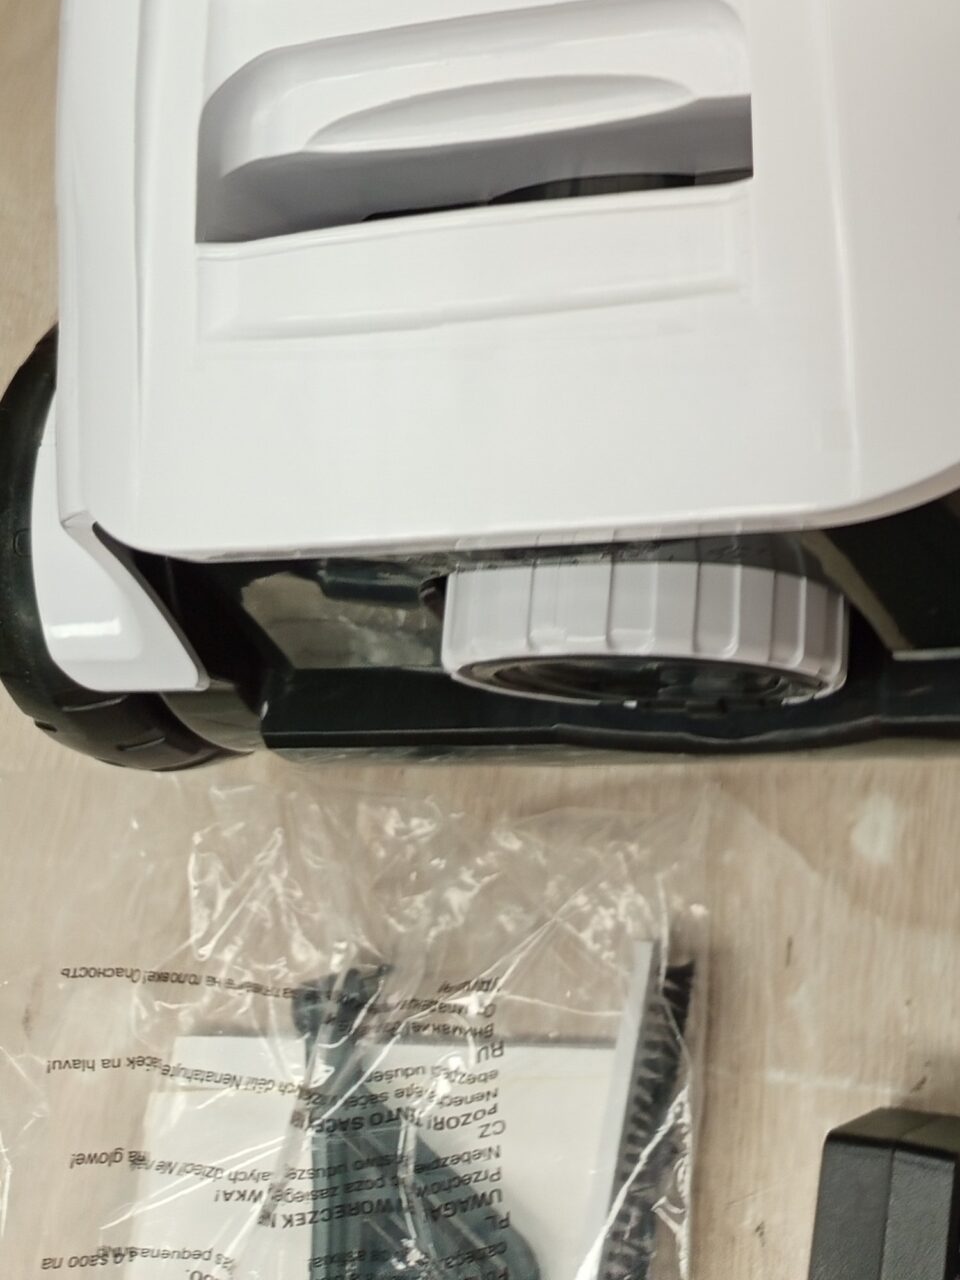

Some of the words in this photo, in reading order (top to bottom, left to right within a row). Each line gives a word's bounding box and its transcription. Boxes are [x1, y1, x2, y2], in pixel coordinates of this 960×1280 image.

[476, 1040, 505, 1064] RU
[45, 1058, 97, 1074] hlavu!
[100, 1058, 121, 1071] na
[478, 1120, 507, 1138] CZ
[41, 1257, 65, 1271] na
